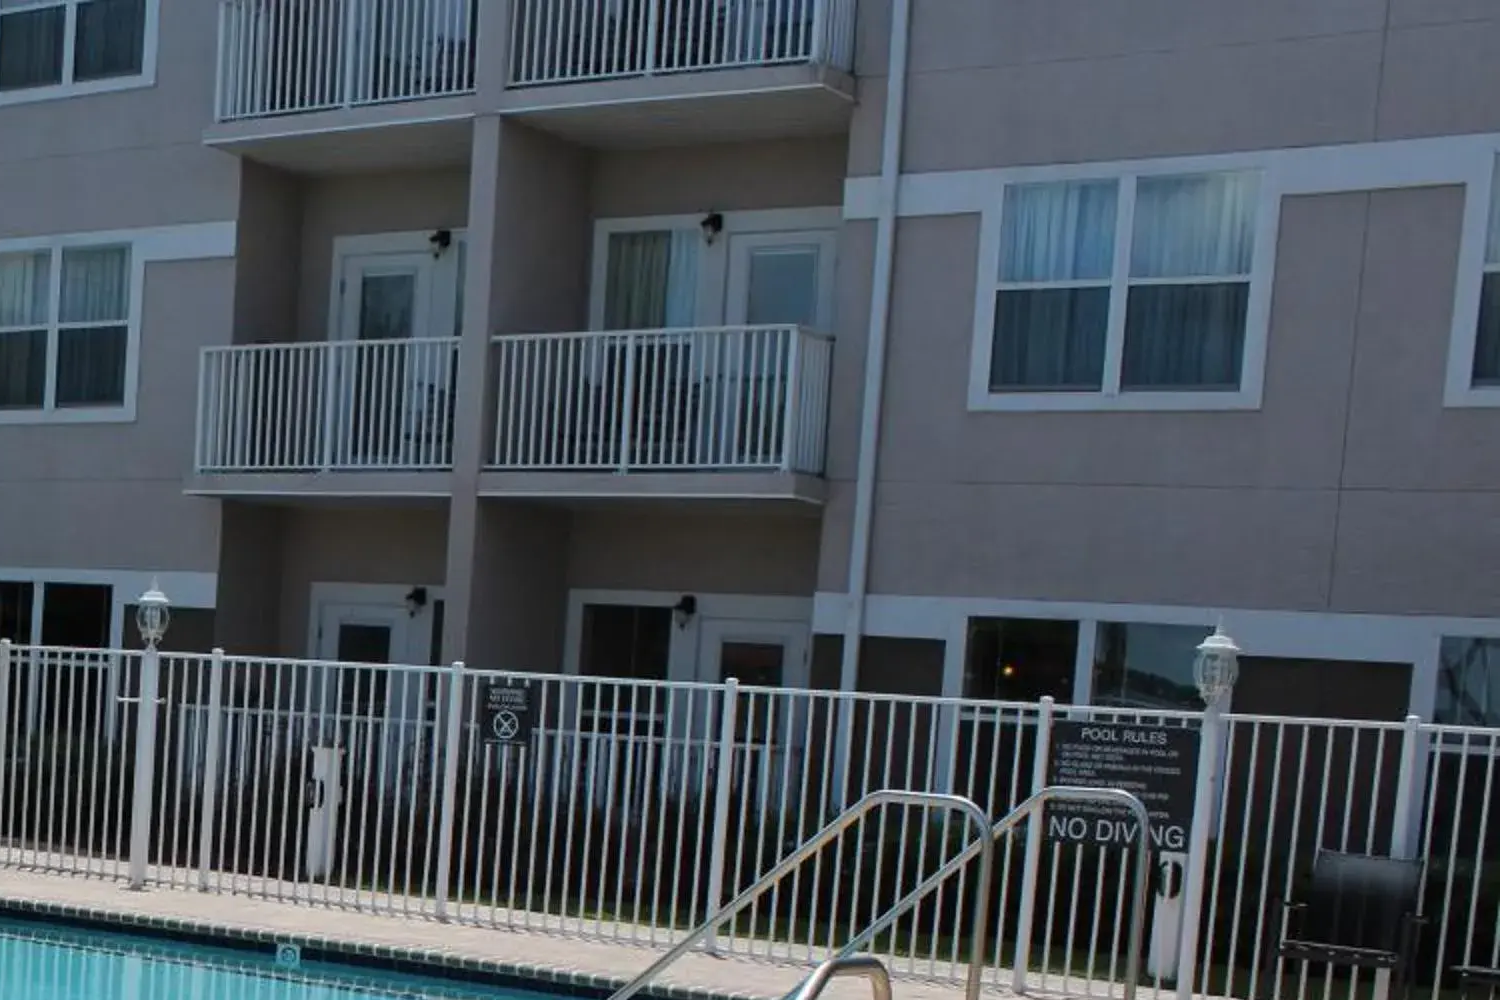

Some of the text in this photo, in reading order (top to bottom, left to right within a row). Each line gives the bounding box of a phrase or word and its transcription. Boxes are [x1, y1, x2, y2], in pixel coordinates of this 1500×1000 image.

[1081, 727, 1168, 745] POOL RULES
[1049, 816, 1185, 849] NO DIVNG
